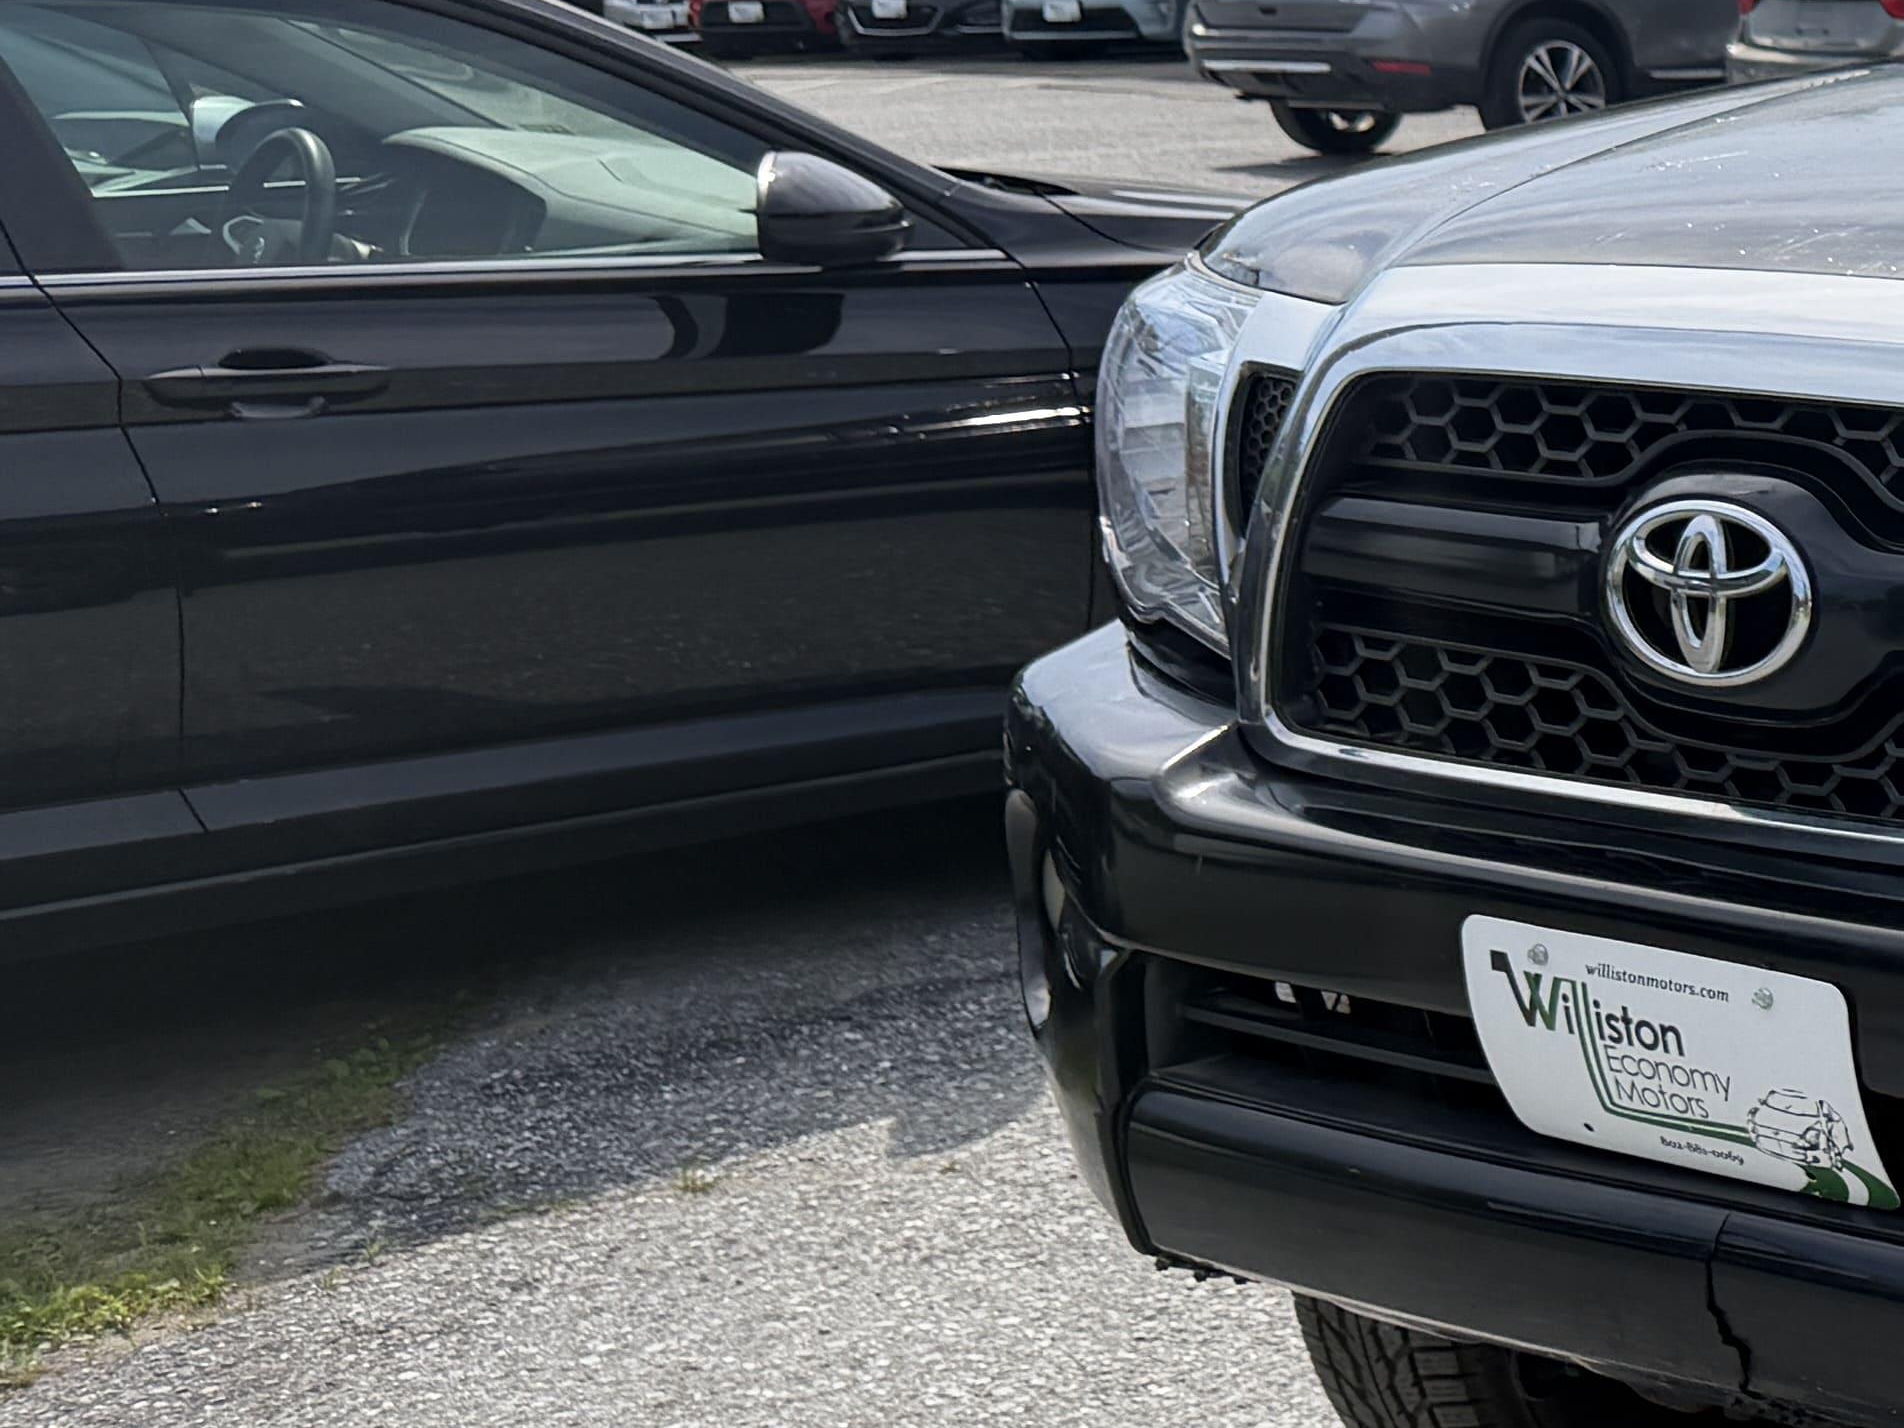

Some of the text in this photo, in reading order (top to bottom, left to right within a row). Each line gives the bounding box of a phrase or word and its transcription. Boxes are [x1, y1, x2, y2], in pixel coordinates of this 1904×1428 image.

[1490, 950, 1685, 1056] Williston
[1585, 963, 1729, 1002] willistonmotors.com
[1604, 1044, 1730, 1101] Economy
[1615, 1076, 1709, 1118] Motors
